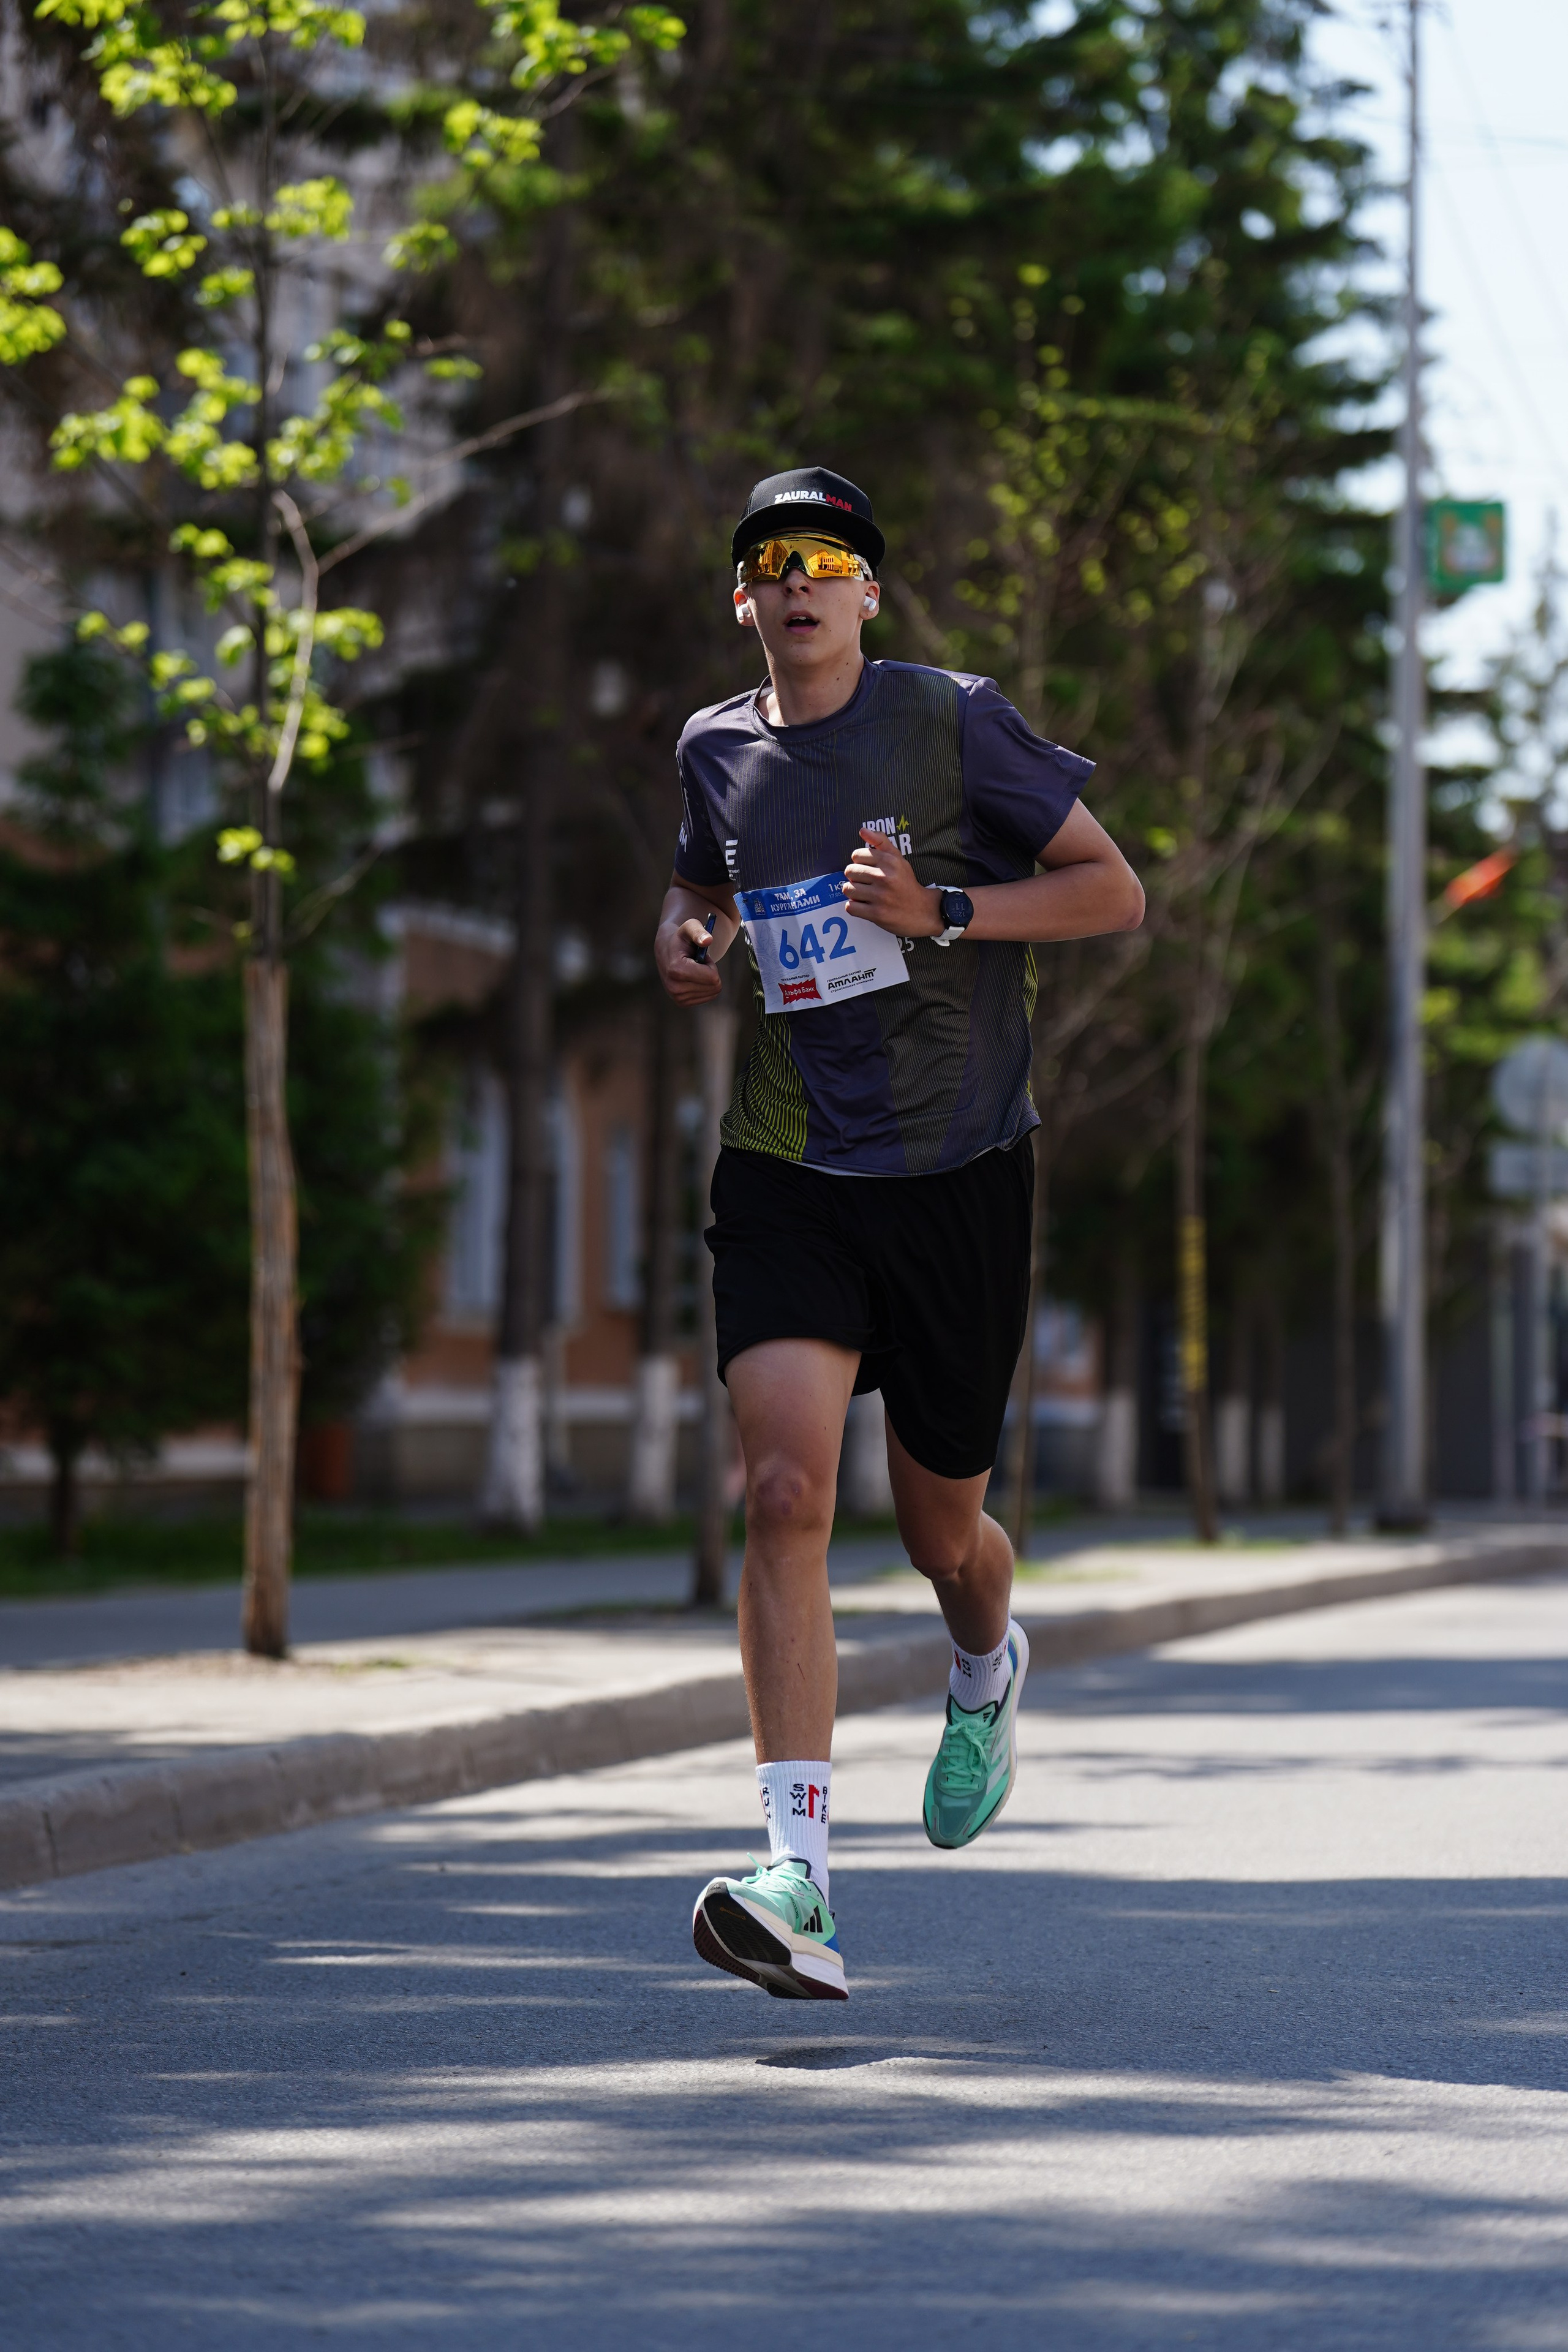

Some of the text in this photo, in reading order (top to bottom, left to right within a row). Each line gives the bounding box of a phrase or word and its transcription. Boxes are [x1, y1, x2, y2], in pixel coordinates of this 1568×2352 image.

[775, 491, 852, 511] ZAURALMAN
[771, 894, 821, 912] КУРГАНАМИ
[774, 888, 807, 901] ТАМ, ЗА
[779, 916, 857, 970] 642
[785, 988, 801, 997] Альфа
[790, 1784, 807, 1817] SWIM
